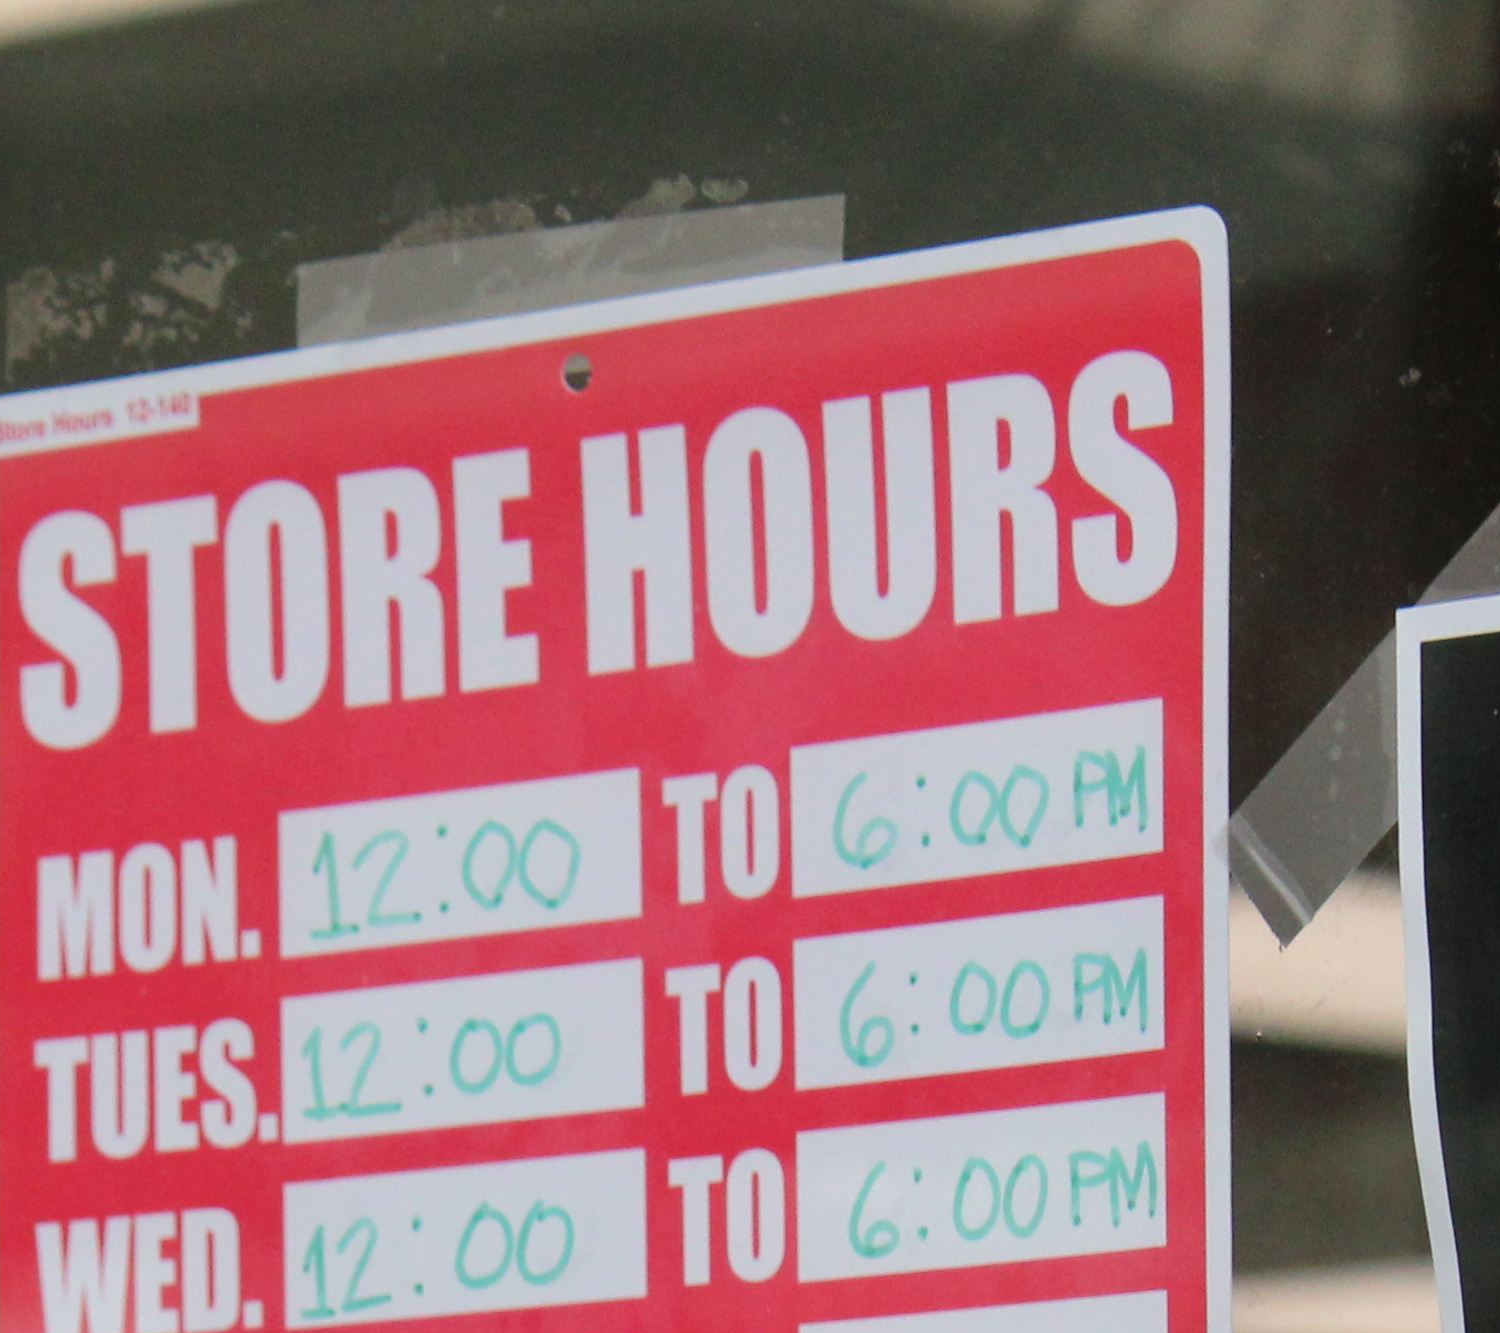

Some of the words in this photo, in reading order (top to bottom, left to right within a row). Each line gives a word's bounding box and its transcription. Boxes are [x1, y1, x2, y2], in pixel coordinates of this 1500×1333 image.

[17, 446, 540, 750] STORE
[579, 351, 1178, 675] HOURS
[38, 836, 261, 981] MON.
[310, 818, 582, 941] 12:00
[662, 765, 780, 905] TO
[34, 1019, 279, 1163] TUES.
[302, 1012, 563, 1121] 12:00
[665, 957, 782, 1095] TO
[301, 1200, 576, 1320] 12:00
[668, 1149, 785, 1286] TO
